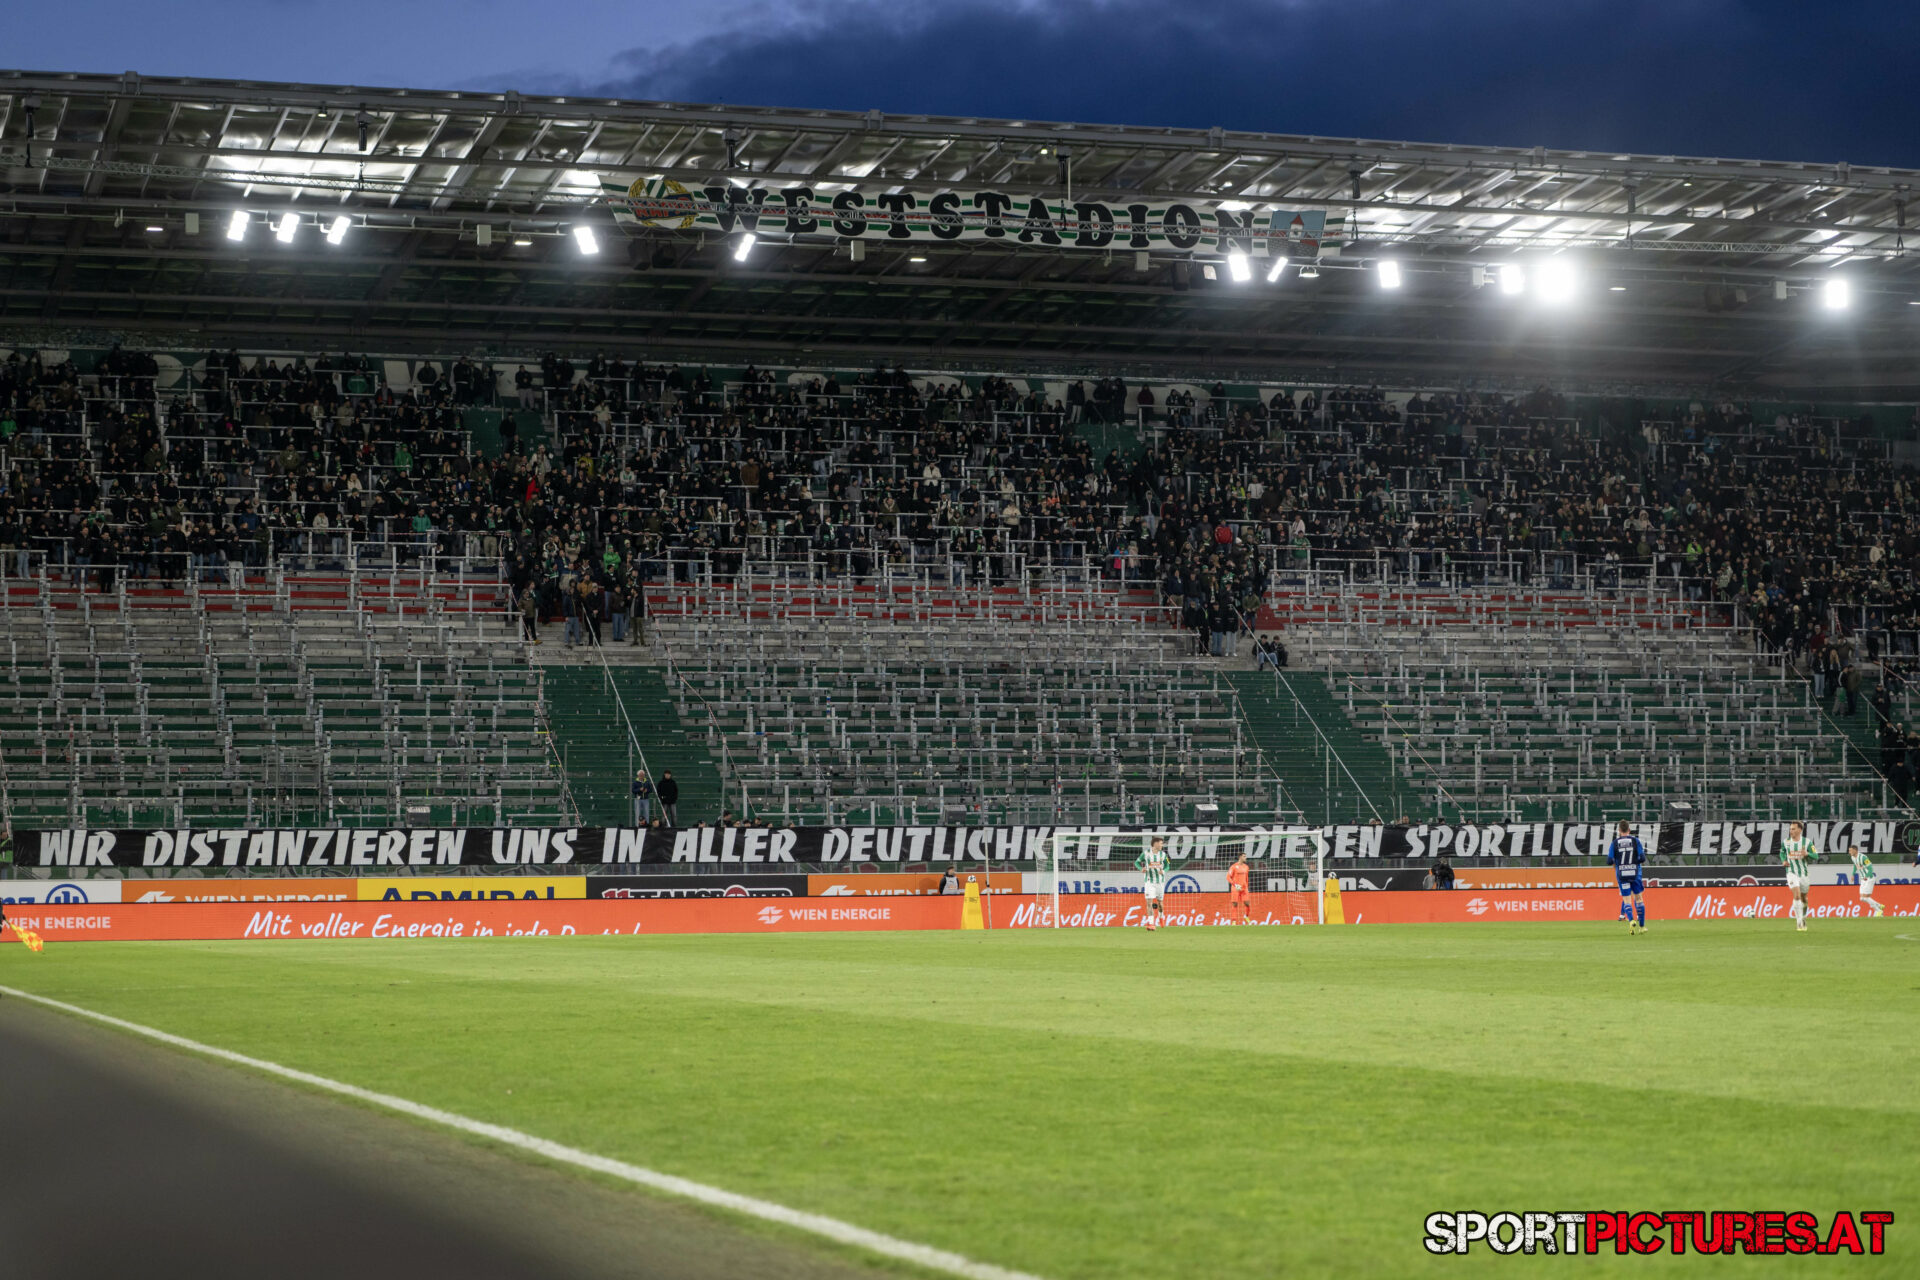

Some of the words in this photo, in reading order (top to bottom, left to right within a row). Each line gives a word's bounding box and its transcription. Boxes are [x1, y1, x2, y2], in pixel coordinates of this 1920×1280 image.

[703, 185, 1256, 252] WESTSTADION
[40, 829, 117, 866] WIR
[143, 829, 466, 866] DISTANZIEREN
[491, 828, 578, 864] UNS
[601, 827, 648, 863] IN
[670, 827, 798, 863] ALLER
[821, 826, 1120, 862] DEUTLICHKEIT
[1244, 825, 1384, 858] DIESEN
[1618, 847, 1634, 865] 77
[788, 908, 828, 920] WIEN
[831, 908, 891, 920] ENERGIE
[1009, 902, 1053, 928] Mit
[1060, 904, 1117, 927] voller
[1493, 900, 1529, 911] WIEN
[1532, 900, 1585, 911] ENERGIE
[1689, 894, 1727, 919] Mit
[44, 916, 112, 929] ENERGIE
[244, 910, 293, 937] Mit
[300, 912, 365, 937] voller
